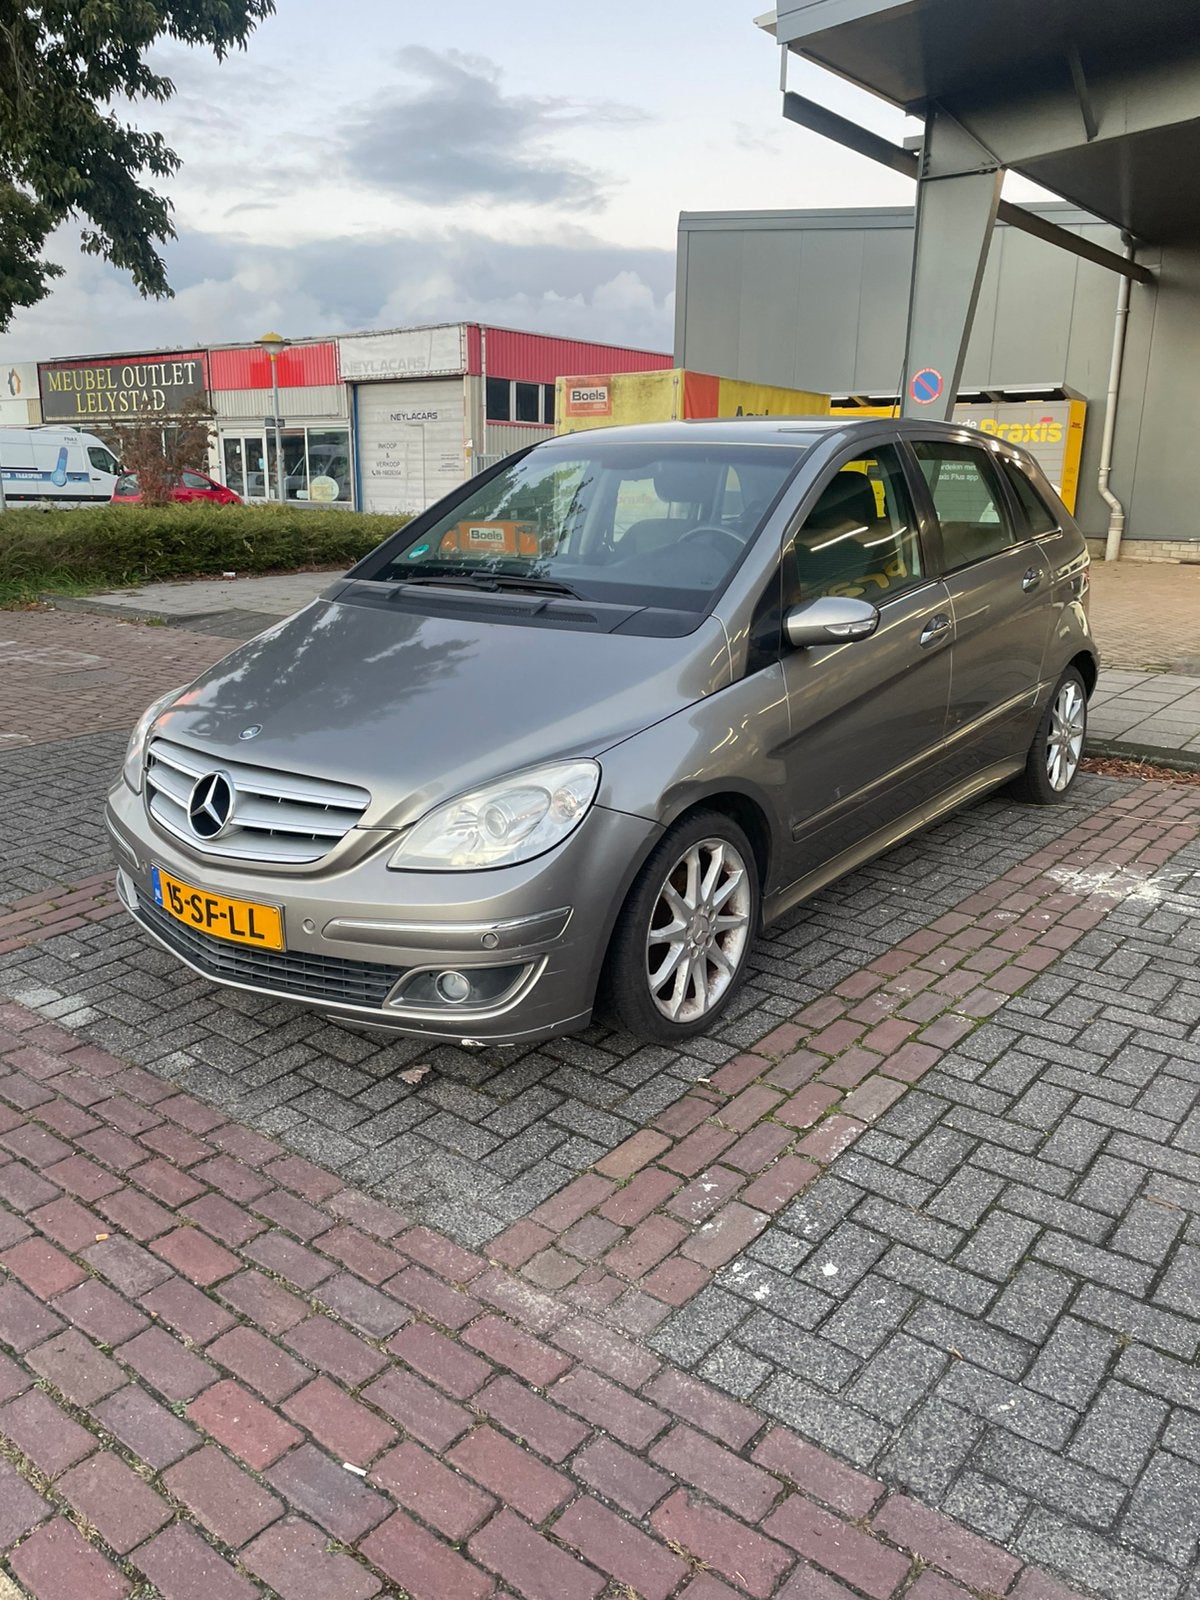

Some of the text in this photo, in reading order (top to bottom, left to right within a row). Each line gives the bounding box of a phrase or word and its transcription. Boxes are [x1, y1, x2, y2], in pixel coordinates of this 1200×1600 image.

[343, 356, 426, 374] NEYLACARS
[48, 362, 196, 392] MEUBEL OUTLET
[76, 389, 166, 413] LELYSTAD
[572, 389, 606, 401] Boels
[390, 412, 438, 421] NEYLACARS
[981, 417, 1063, 443] Praxis
[471, 530, 503, 540] Boels
[166, 882, 265, 940] 15-SF-LL
